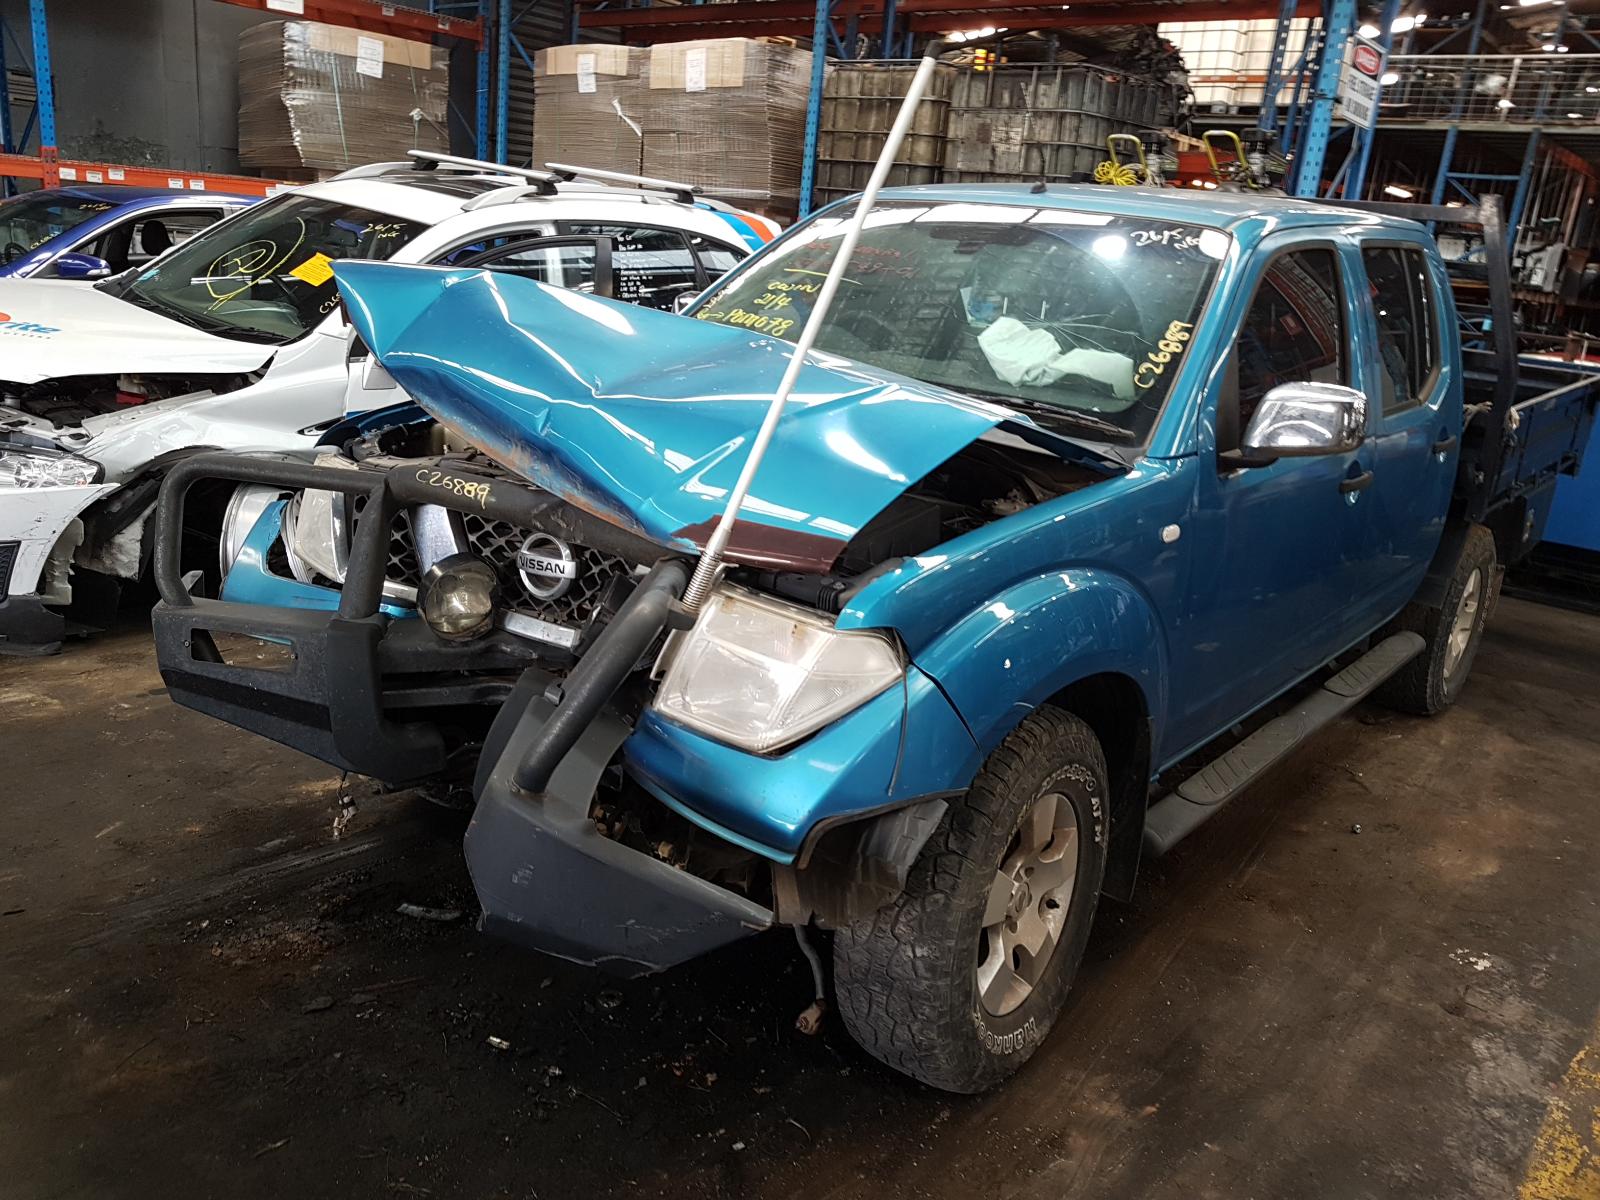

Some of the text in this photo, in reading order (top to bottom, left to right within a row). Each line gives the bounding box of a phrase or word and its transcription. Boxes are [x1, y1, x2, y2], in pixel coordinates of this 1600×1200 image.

[319, 292, 341, 314] C26
[1133, 319, 1194, 389] C26889
[415, 469, 491, 509] C26889
[518, 554, 566, 575] NISSAN
